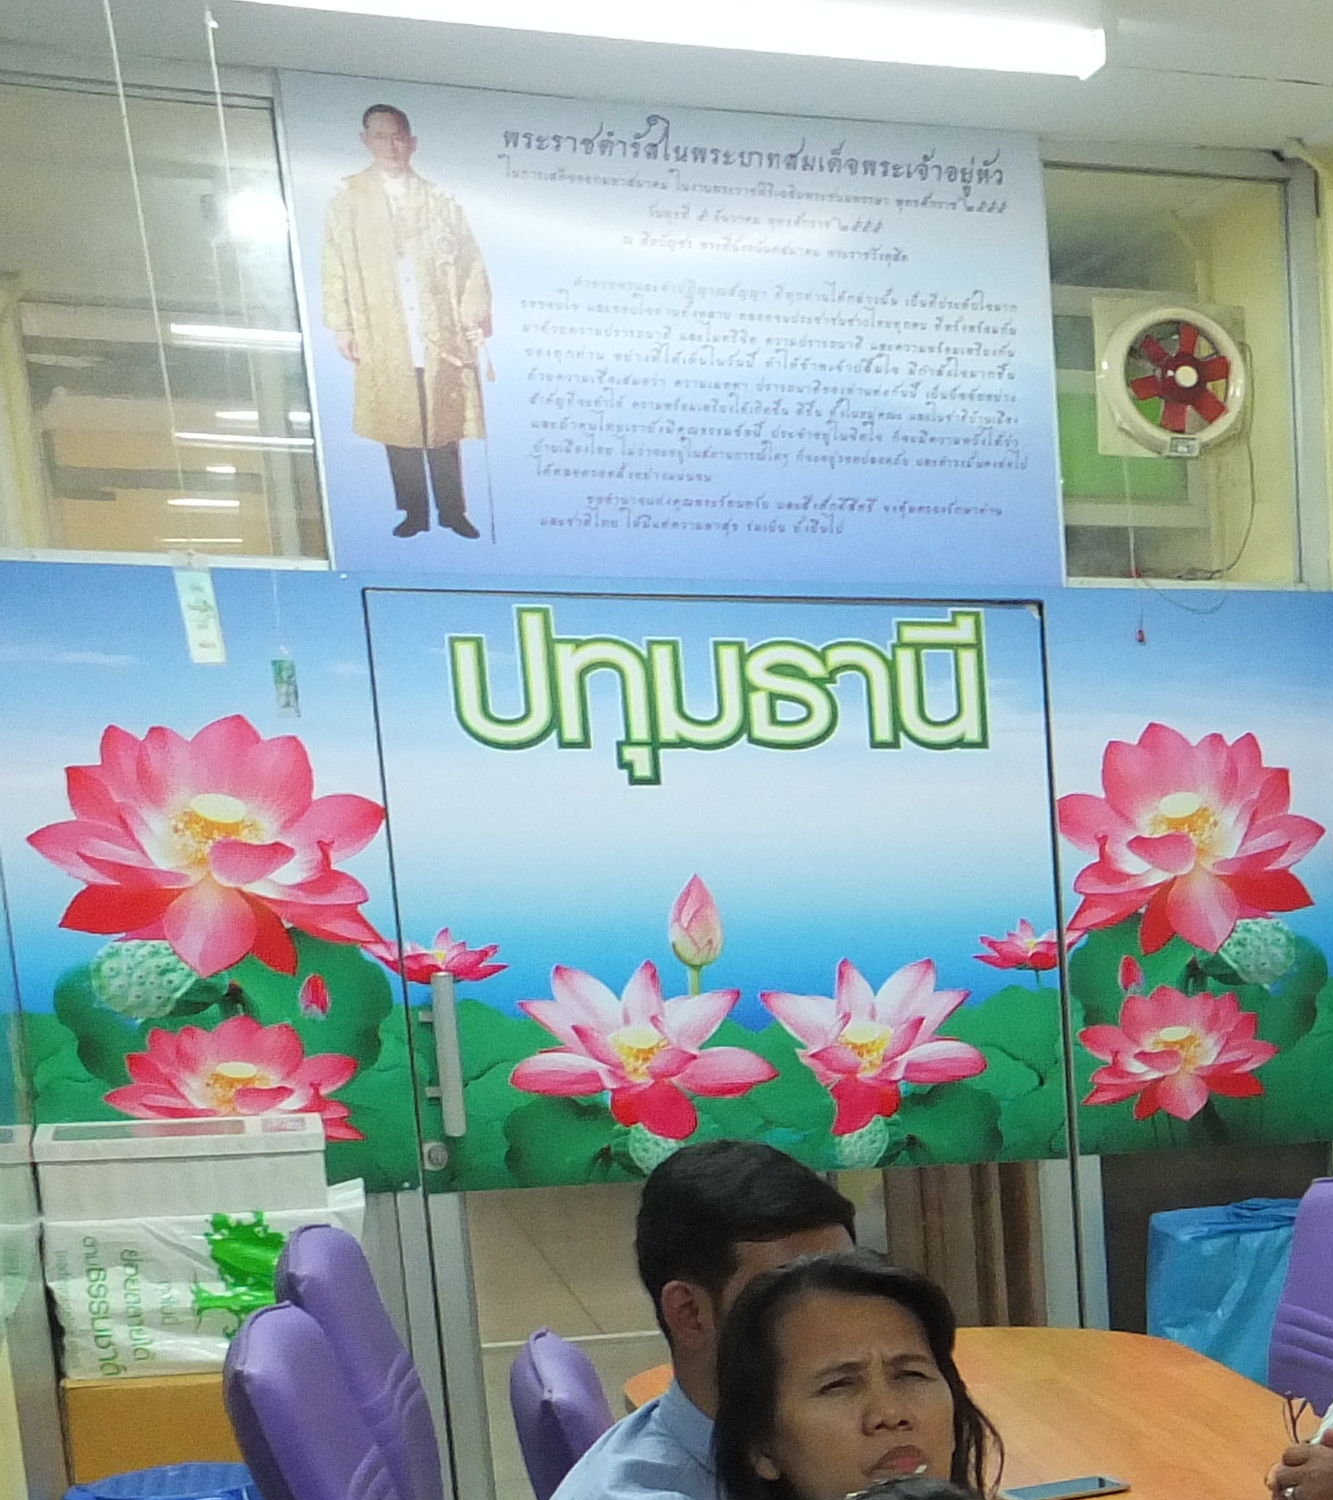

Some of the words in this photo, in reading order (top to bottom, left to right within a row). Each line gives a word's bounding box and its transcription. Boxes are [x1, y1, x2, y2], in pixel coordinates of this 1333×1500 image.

[503, 114, 1004, 197] พระราชดำรัสในพระบาทสมเด็จพระเจ้าอยู่หัว
[444, 604, 990, 786] ปทุมธานี
[83, 1236, 127, 1376] ตามธรรมชาติ
